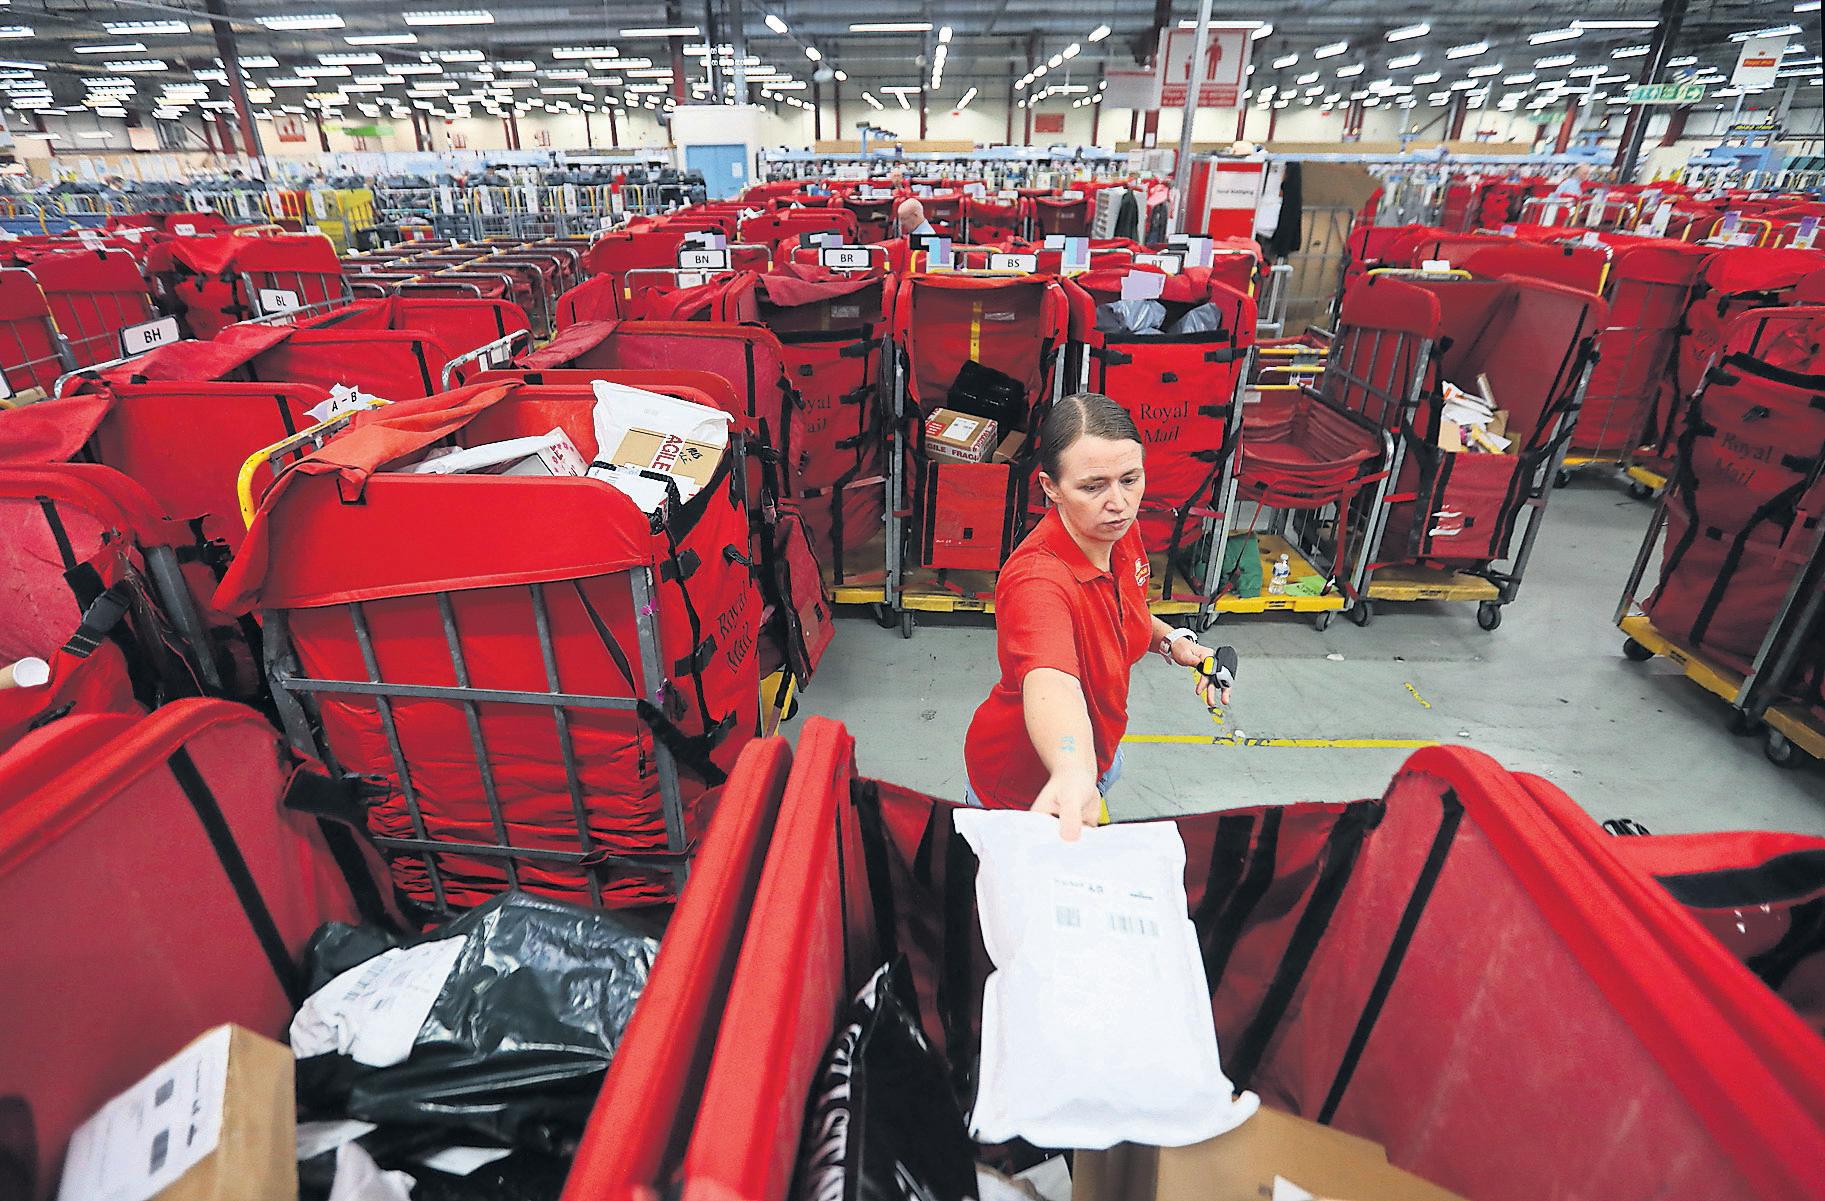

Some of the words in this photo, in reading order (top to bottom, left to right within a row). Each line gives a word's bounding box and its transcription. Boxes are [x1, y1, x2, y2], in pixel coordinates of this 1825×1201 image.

[695, 255, 709, 264] BN
[840, 253, 853, 263] BR
[1007, 258, 1020, 268] BS
[275, 295, 287, 307] BL
[144, 328, 162, 344] BH
[331, 400, 339, 412] A
[350, 391, 357, 403] B
[1140, 400, 1189, 424] Royal
[807, 416, 827, 433] ail
[1144, 425, 1180, 444] Mail
[651, 434, 683, 472] AGILE
[715, 579, 747, 641] Royal
[726, 620, 753, 675] Mail
